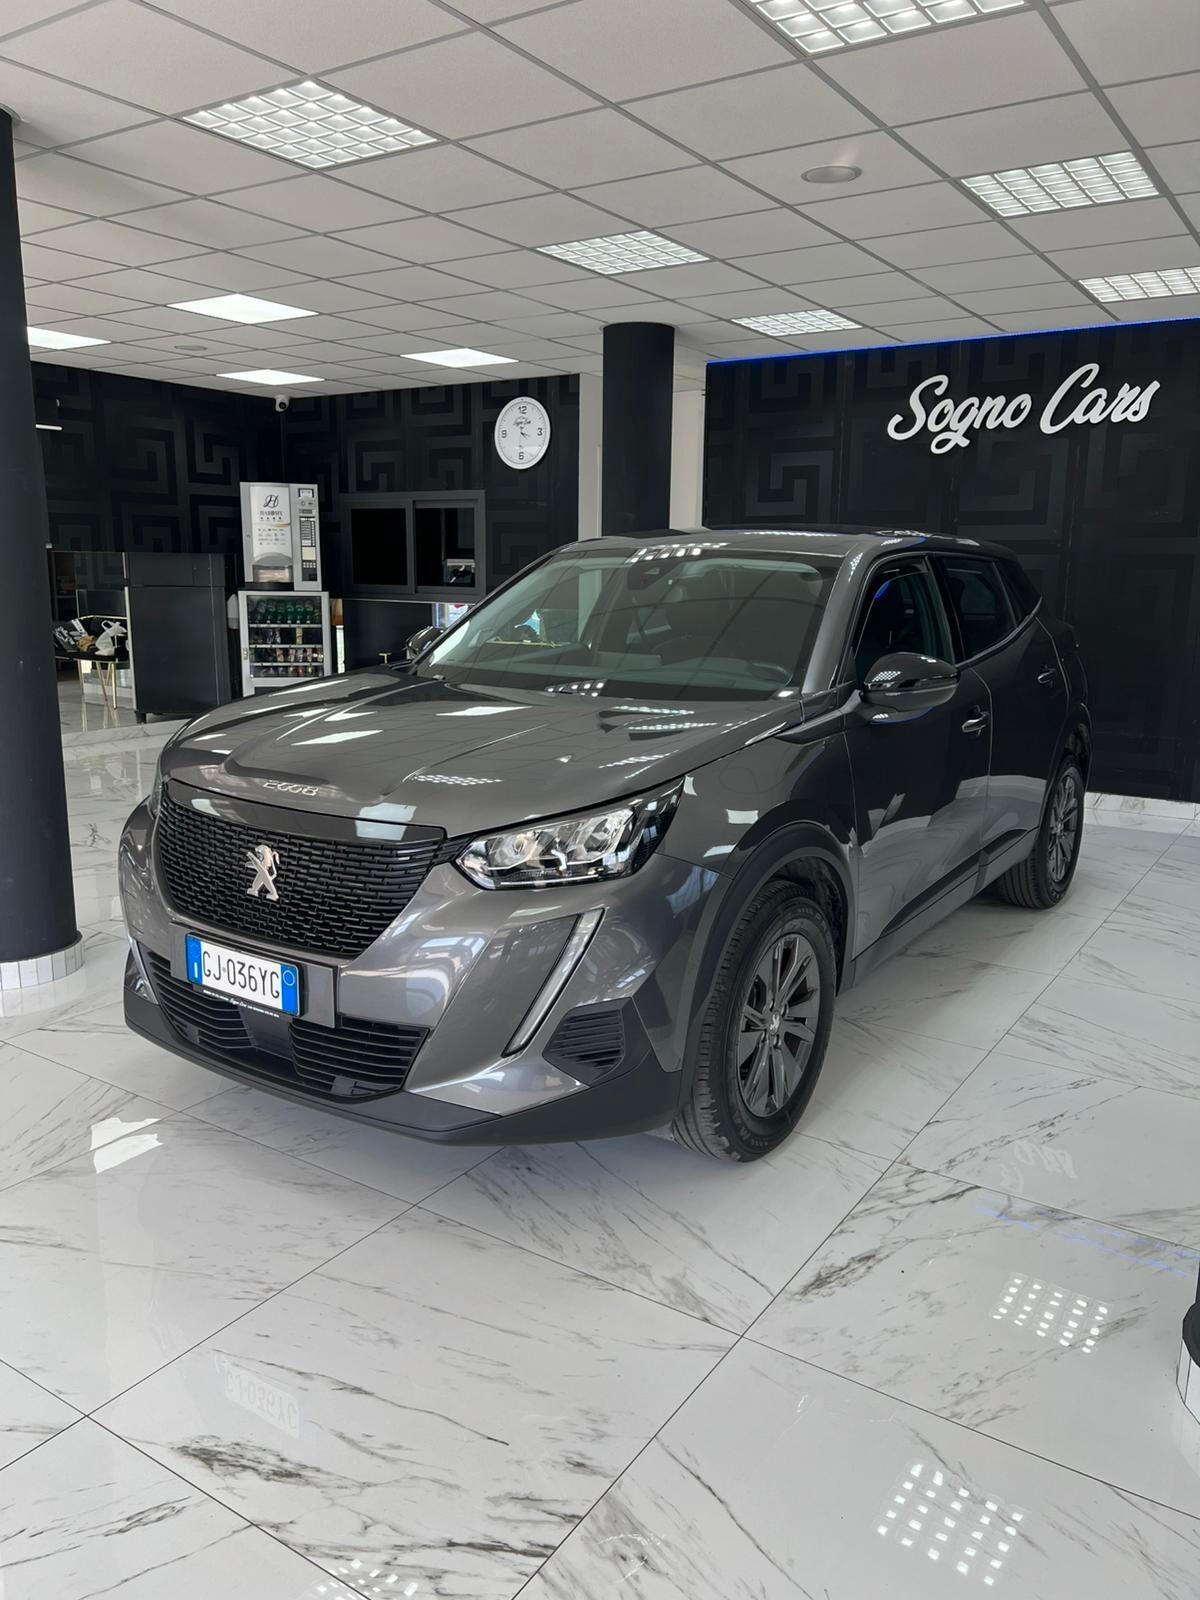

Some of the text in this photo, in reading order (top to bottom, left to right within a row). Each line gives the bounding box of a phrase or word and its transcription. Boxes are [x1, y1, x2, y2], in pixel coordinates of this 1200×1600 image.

[518, 405, 527, 415] 12
[887, 363, 1161, 454] Sogno Cars
[501, 429, 507, 439] 9
[537, 427, 543, 437] 3
[518, 451, 525, 460] 6
